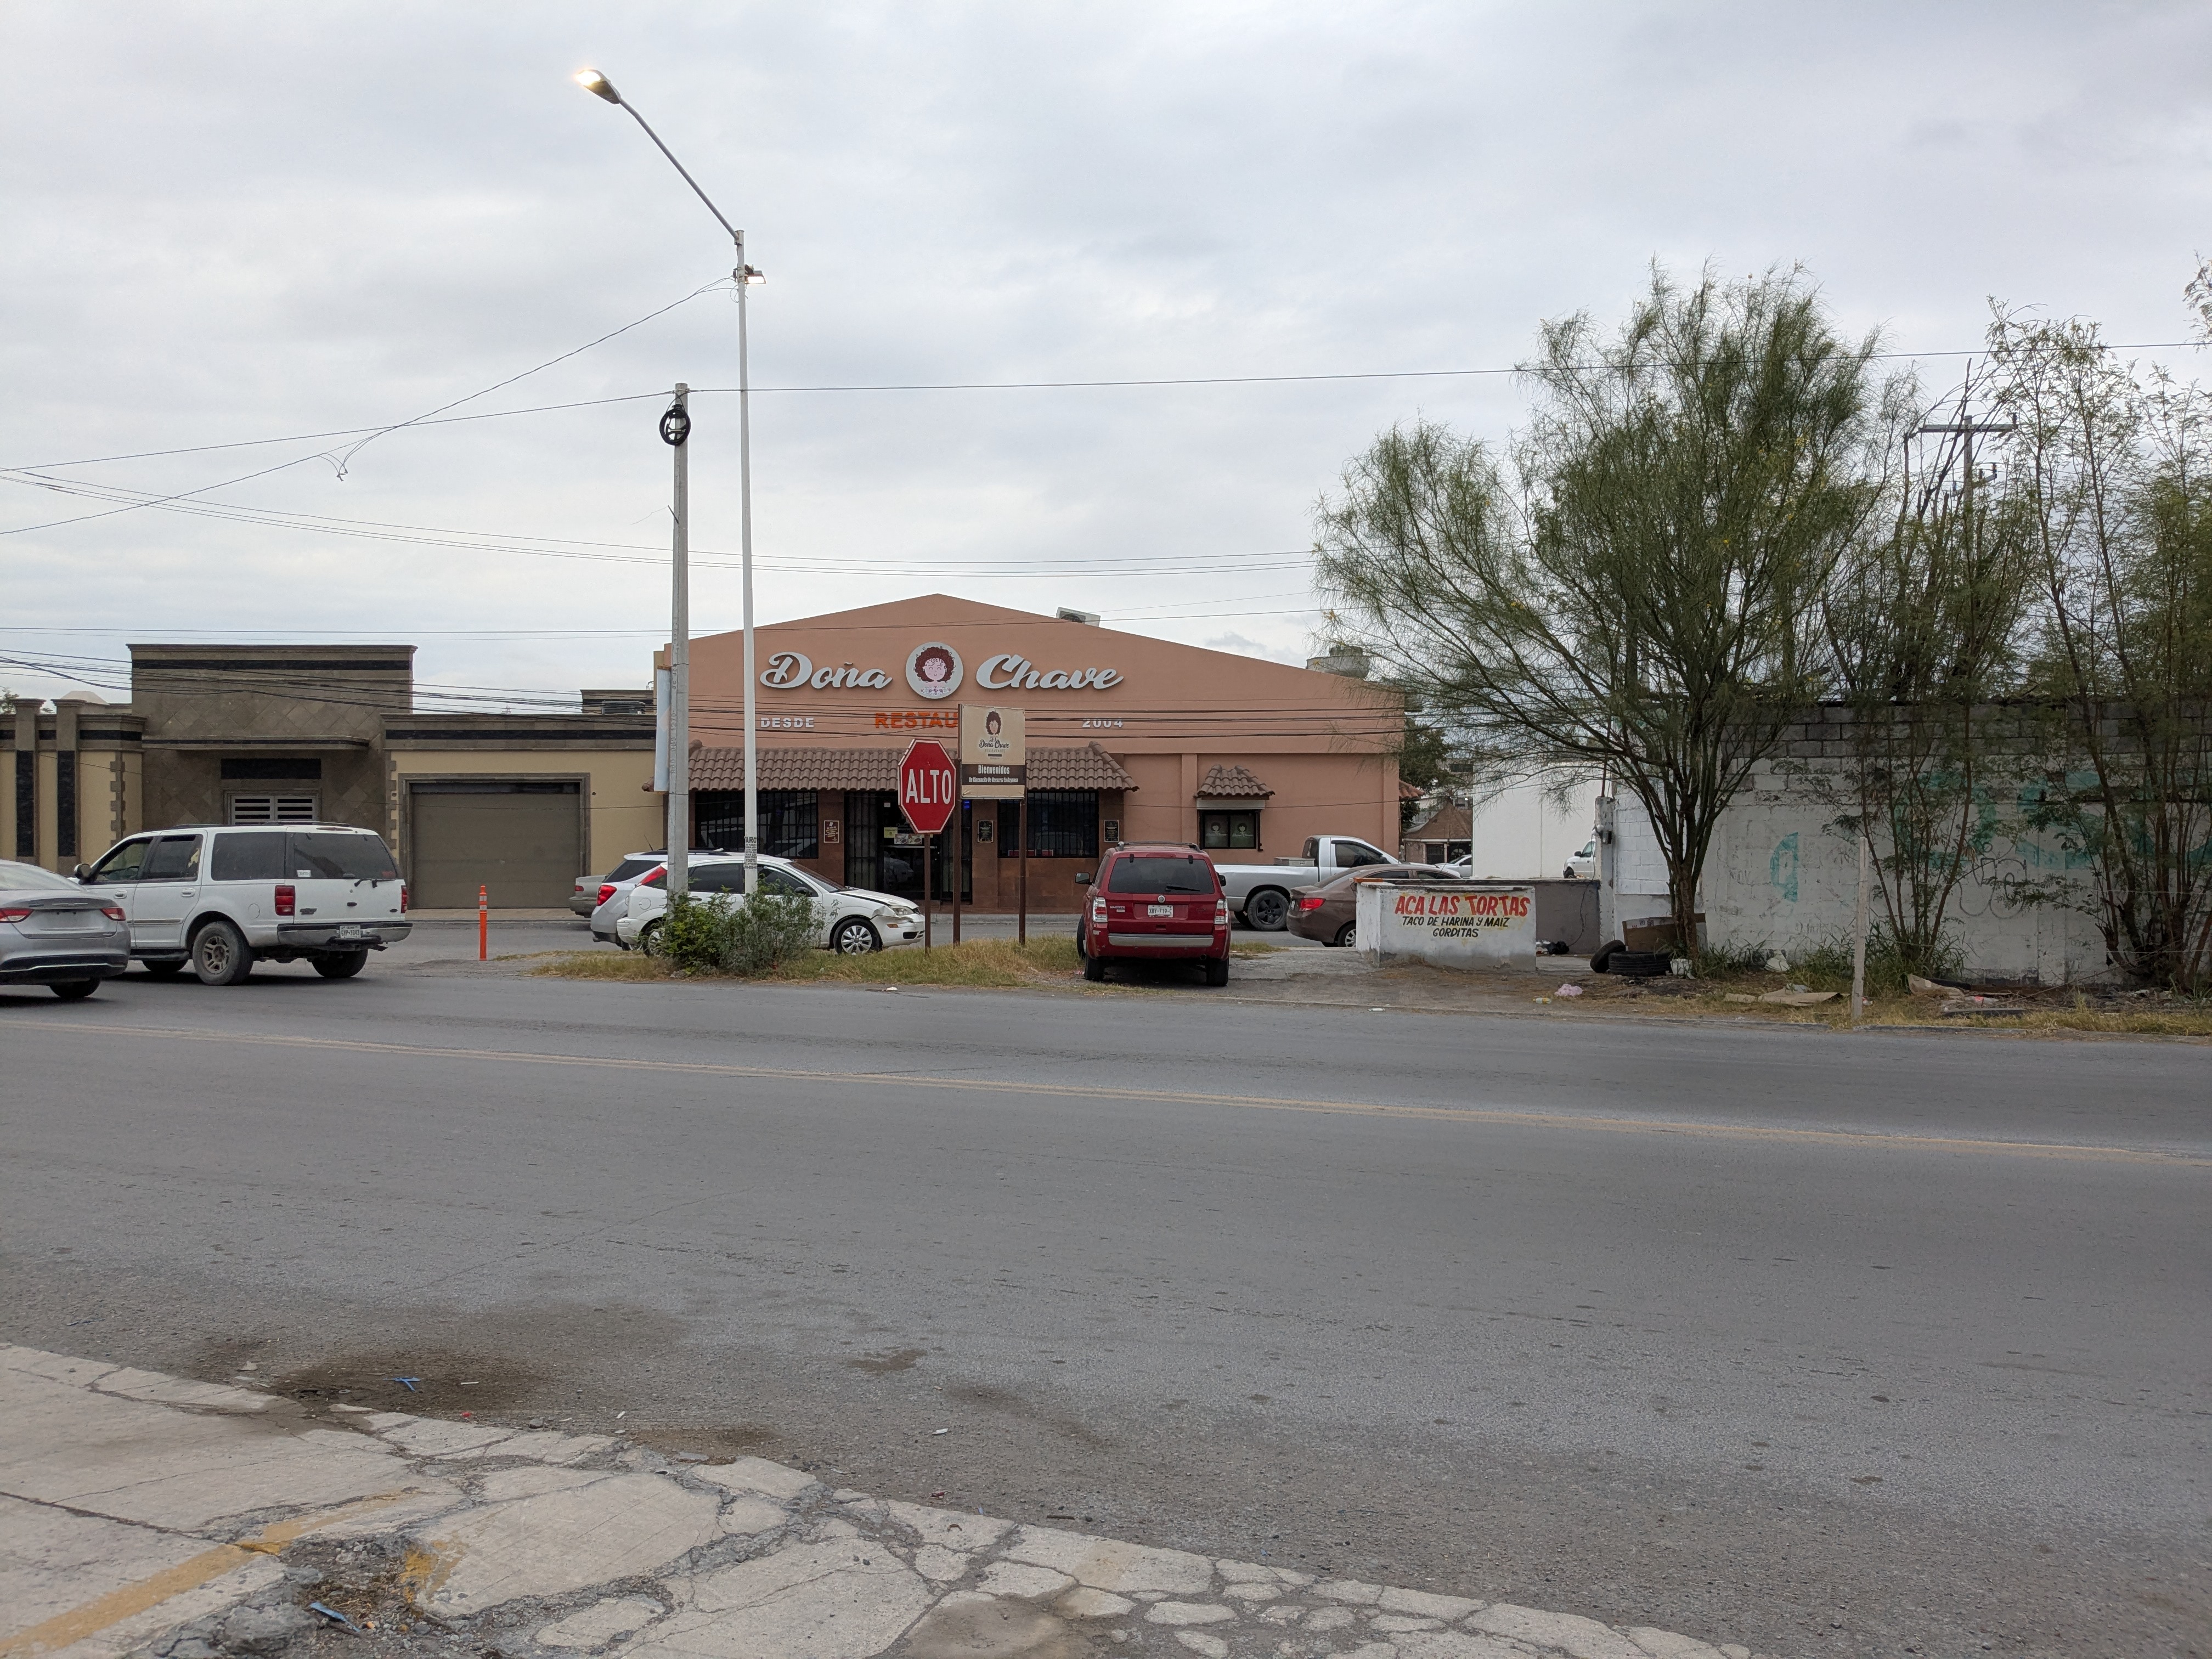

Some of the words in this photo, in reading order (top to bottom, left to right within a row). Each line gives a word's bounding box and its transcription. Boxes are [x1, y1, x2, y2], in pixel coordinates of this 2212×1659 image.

[760, 652, 893, 689] Doña
[976, 654, 1125, 690] Chave
[760, 717, 815, 729] DESDE
[1082, 718, 1124, 729] 2004
[978, 765, 1009, 774] Bienvenidos
[906, 769, 952, 804] ALTO
[1394, 895, 1425, 915] ACA
[1428, 895, 1460, 916] LAS
[1464, 895, 1531, 917] TORTAS
[1402, 916, 1425, 926] TACO
[1426, 916, 1438, 926] DE
[1441, 916, 1474, 927] HARINA
[1432, 928, 1479, 938] GORDITAS
